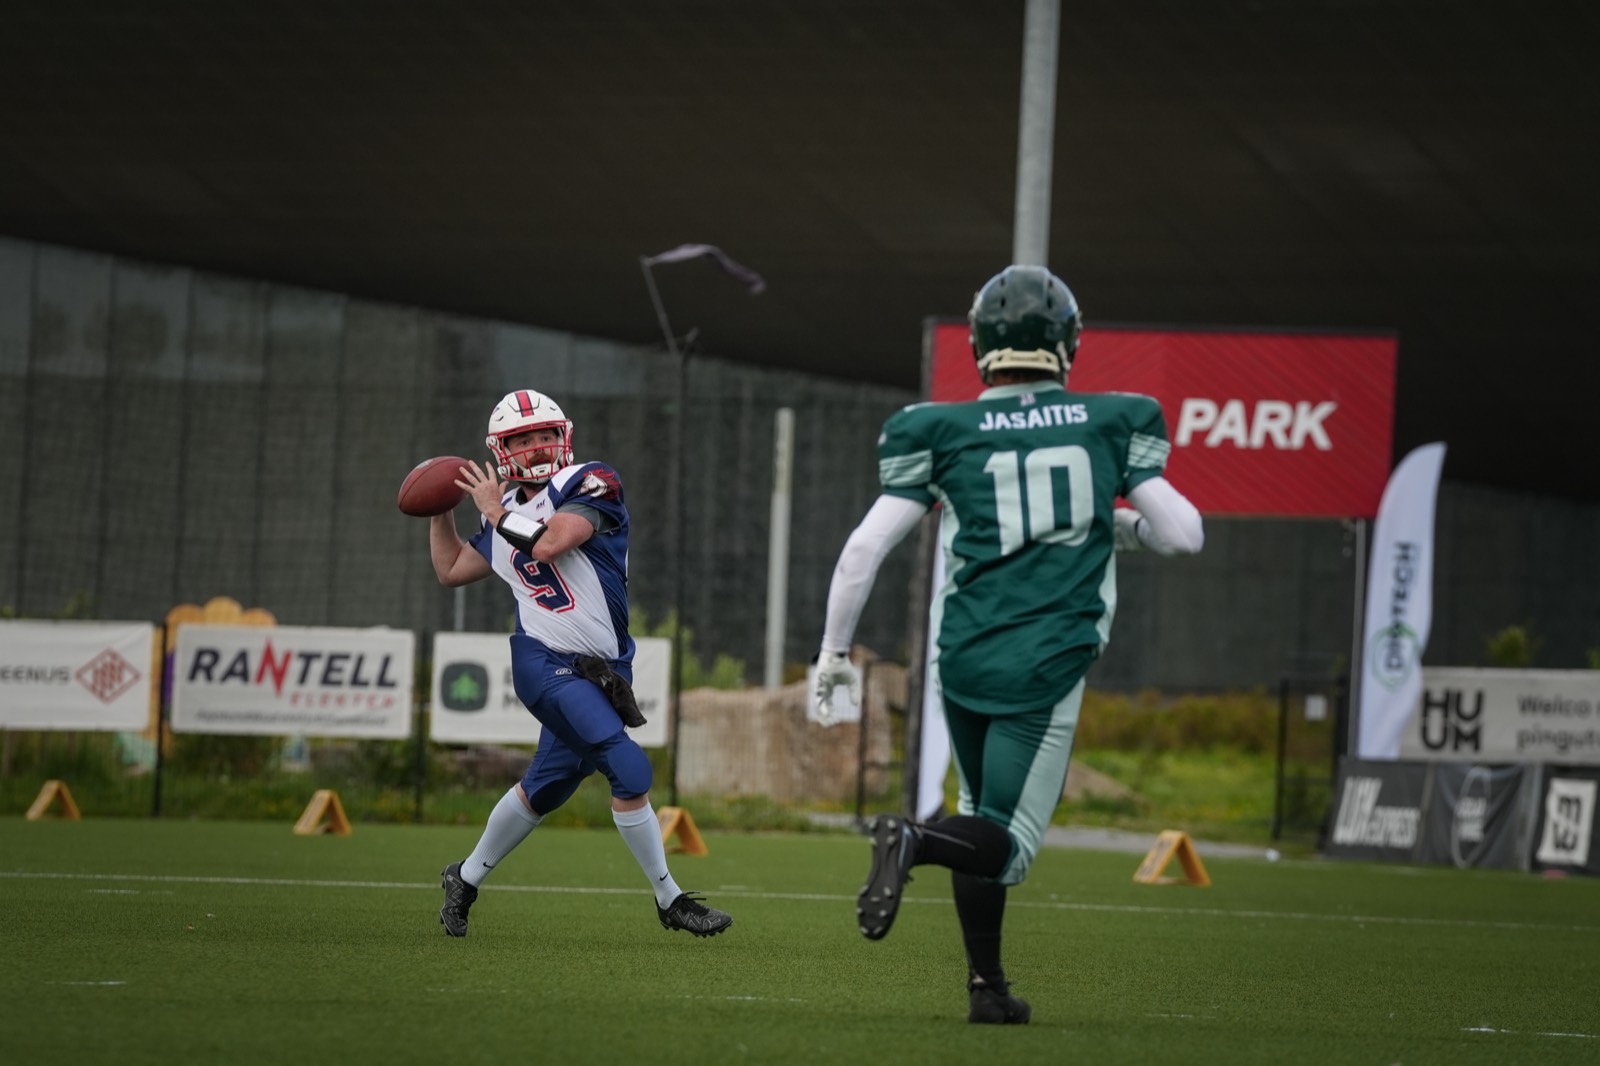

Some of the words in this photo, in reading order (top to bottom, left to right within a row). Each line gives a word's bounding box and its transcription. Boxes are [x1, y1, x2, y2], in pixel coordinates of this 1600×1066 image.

[979, 404, 1089, 431] JASAITIS
[1174, 398, 1337, 450] PARK
[983, 445, 1095, 556] 10
[510, 547, 575, 614] 9
[187, 637, 397, 697] RANTELL
